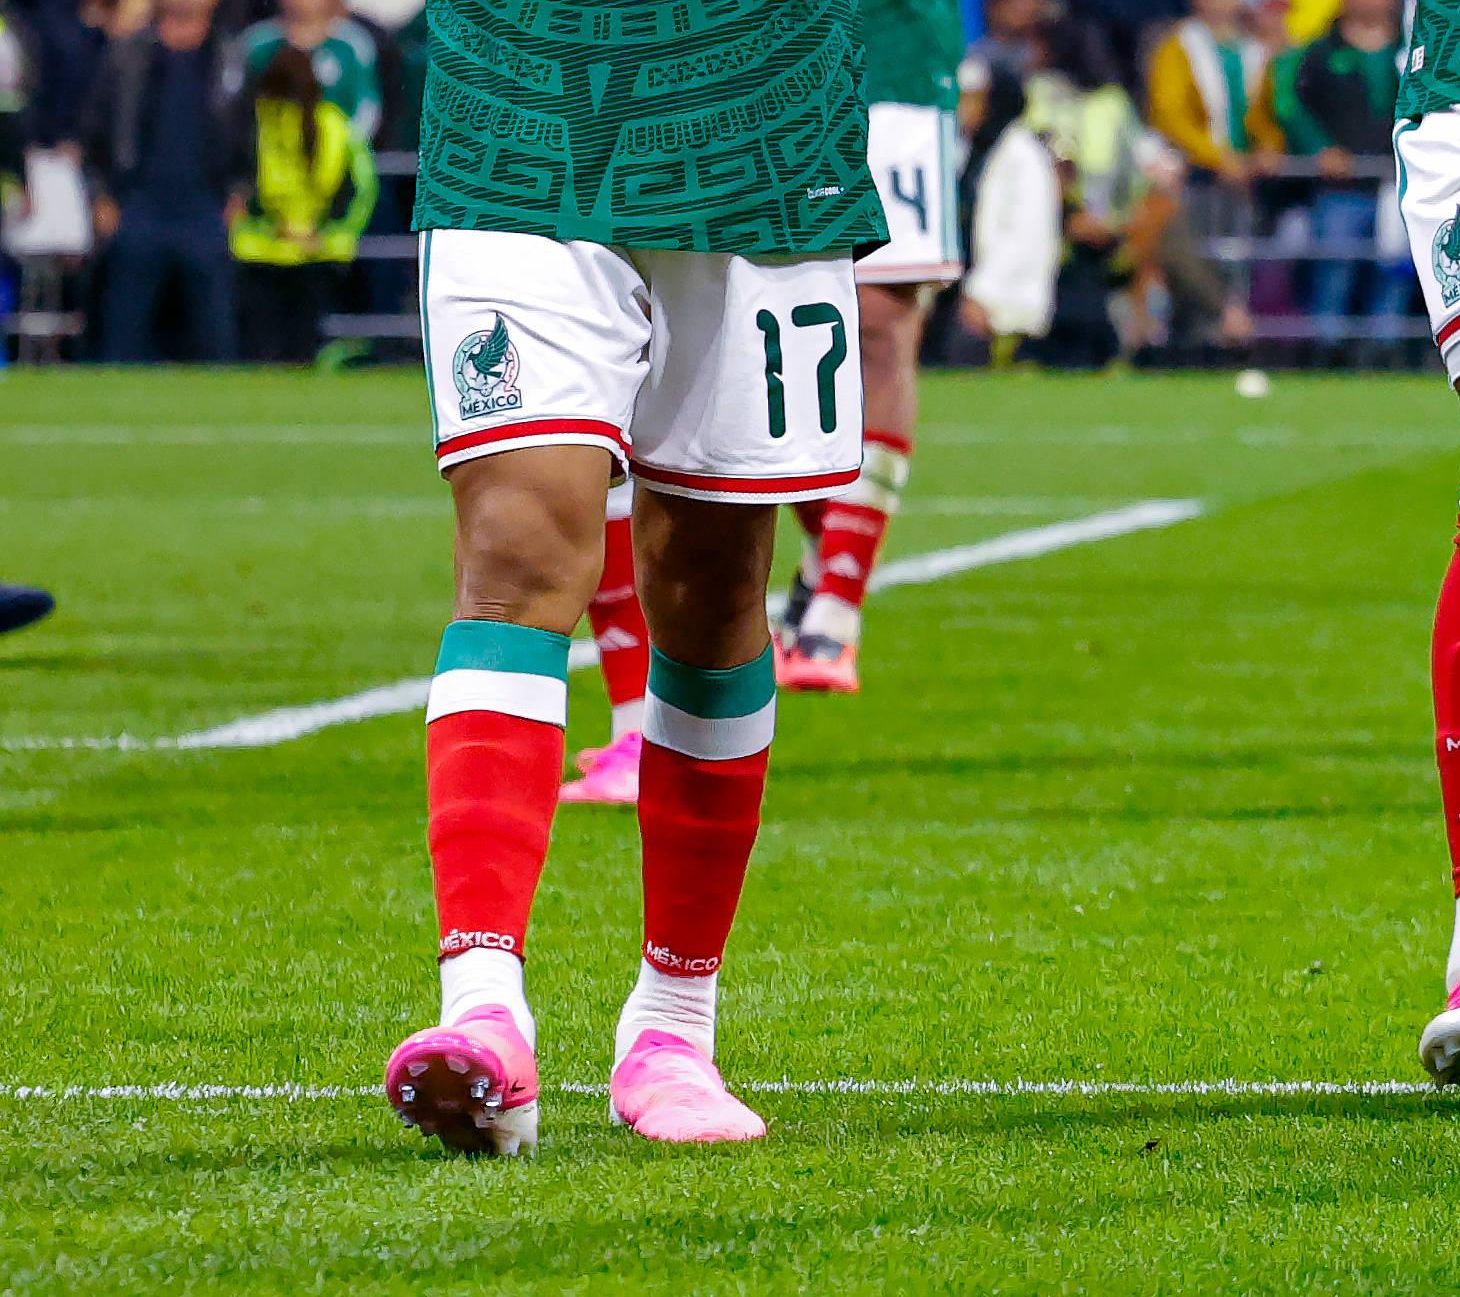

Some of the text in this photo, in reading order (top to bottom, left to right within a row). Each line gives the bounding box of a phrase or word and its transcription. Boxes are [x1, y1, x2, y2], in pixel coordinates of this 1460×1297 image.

[891, 167, 929, 234] 4
[756, 302, 848, 438] 17
[461, 393, 519, 417] MÉXICO
[439, 929, 516, 952] MÉXICO
[645, 939, 719, 973] MÉXICO
